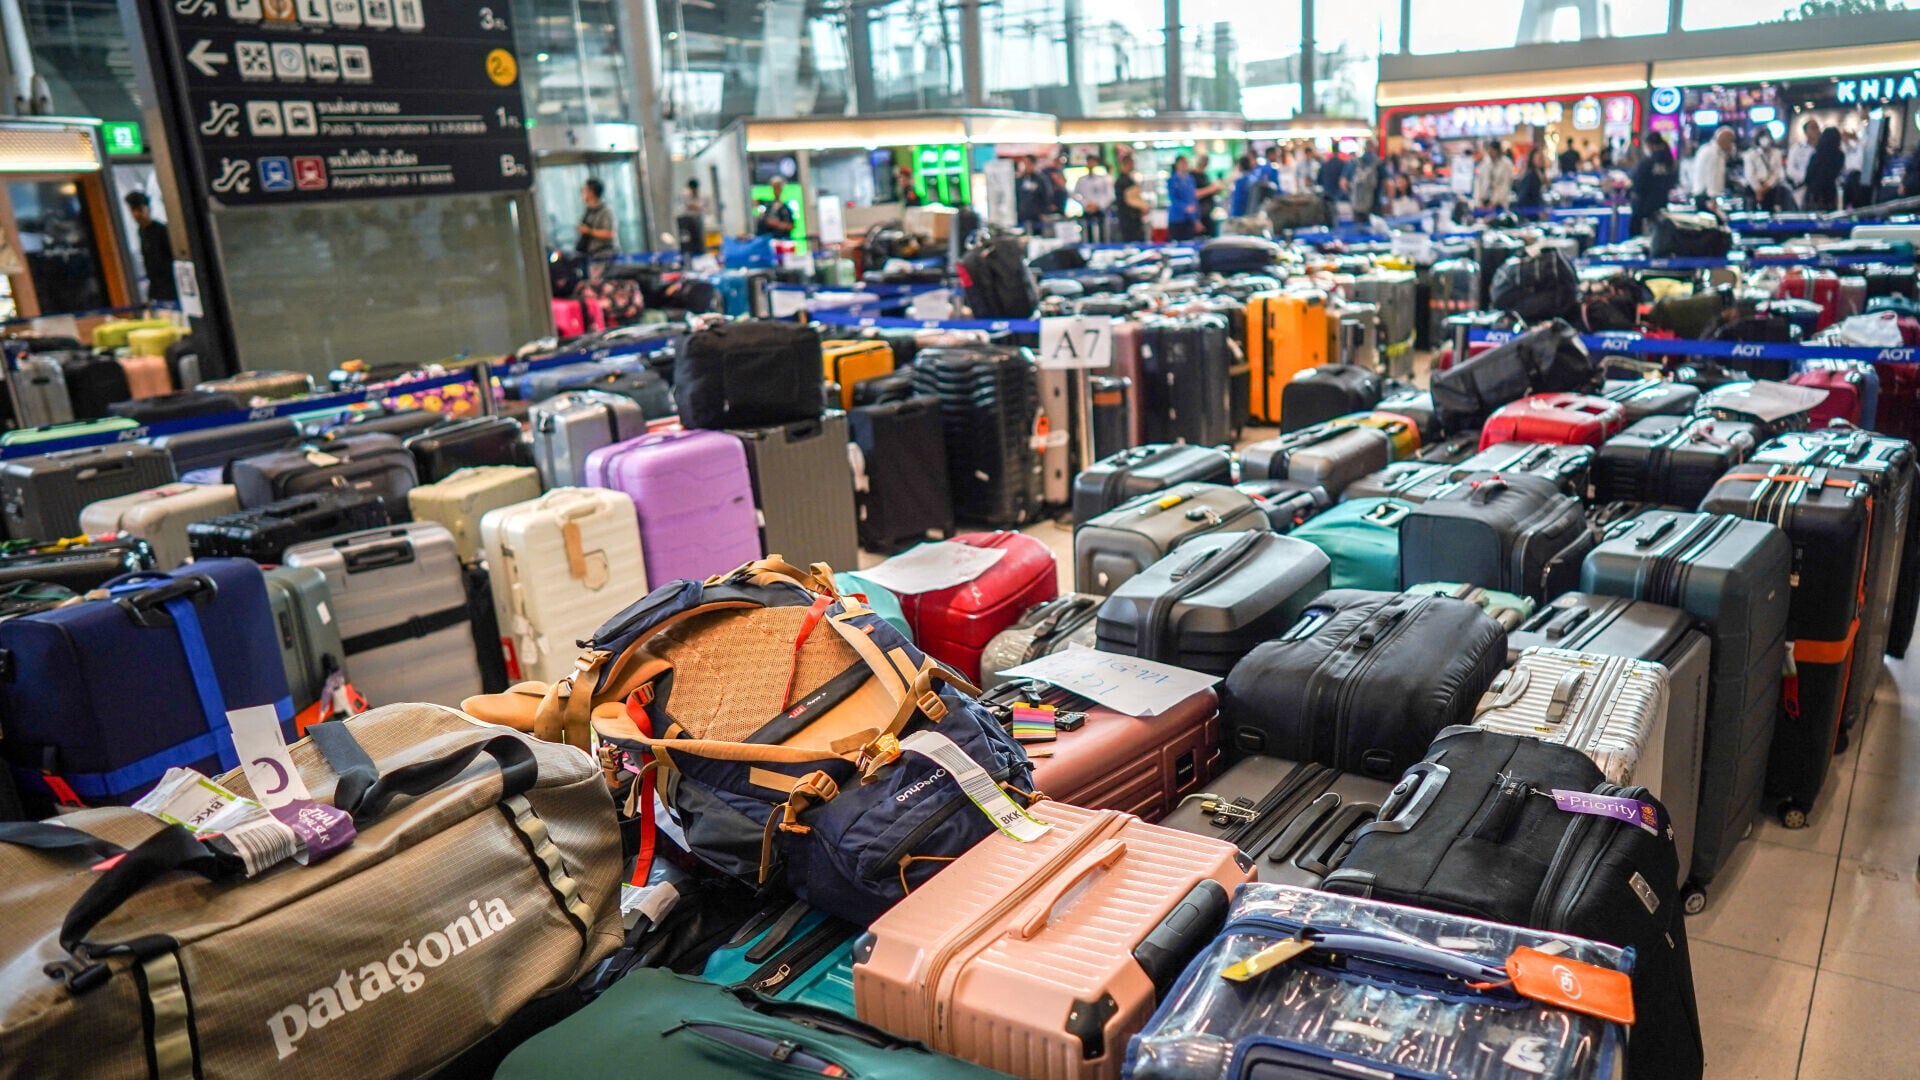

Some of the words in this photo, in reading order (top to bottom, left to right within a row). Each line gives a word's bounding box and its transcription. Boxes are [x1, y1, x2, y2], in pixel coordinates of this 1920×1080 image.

[1838, 67, 1920, 103] KHIA
[1052, 329, 1100, 358] A7
[1485, 331, 1512, 343] AOT
[1602, 339, 1632, 351] AOT
[1731, 343, 1765, 357] AOT
[1877, 348, 1916, 361] AOT
[248, 407, 278, 420] AOT
[118, 426, 149, 441] AOT
[896, 768, 946, 802] Quechua
[190, 801, 224, 824] BKK
[1570, 795, 1637, 819] Priority
[1000, 809, 1022, 825] BKK
[266, 897, 516, 1060] patagonia
